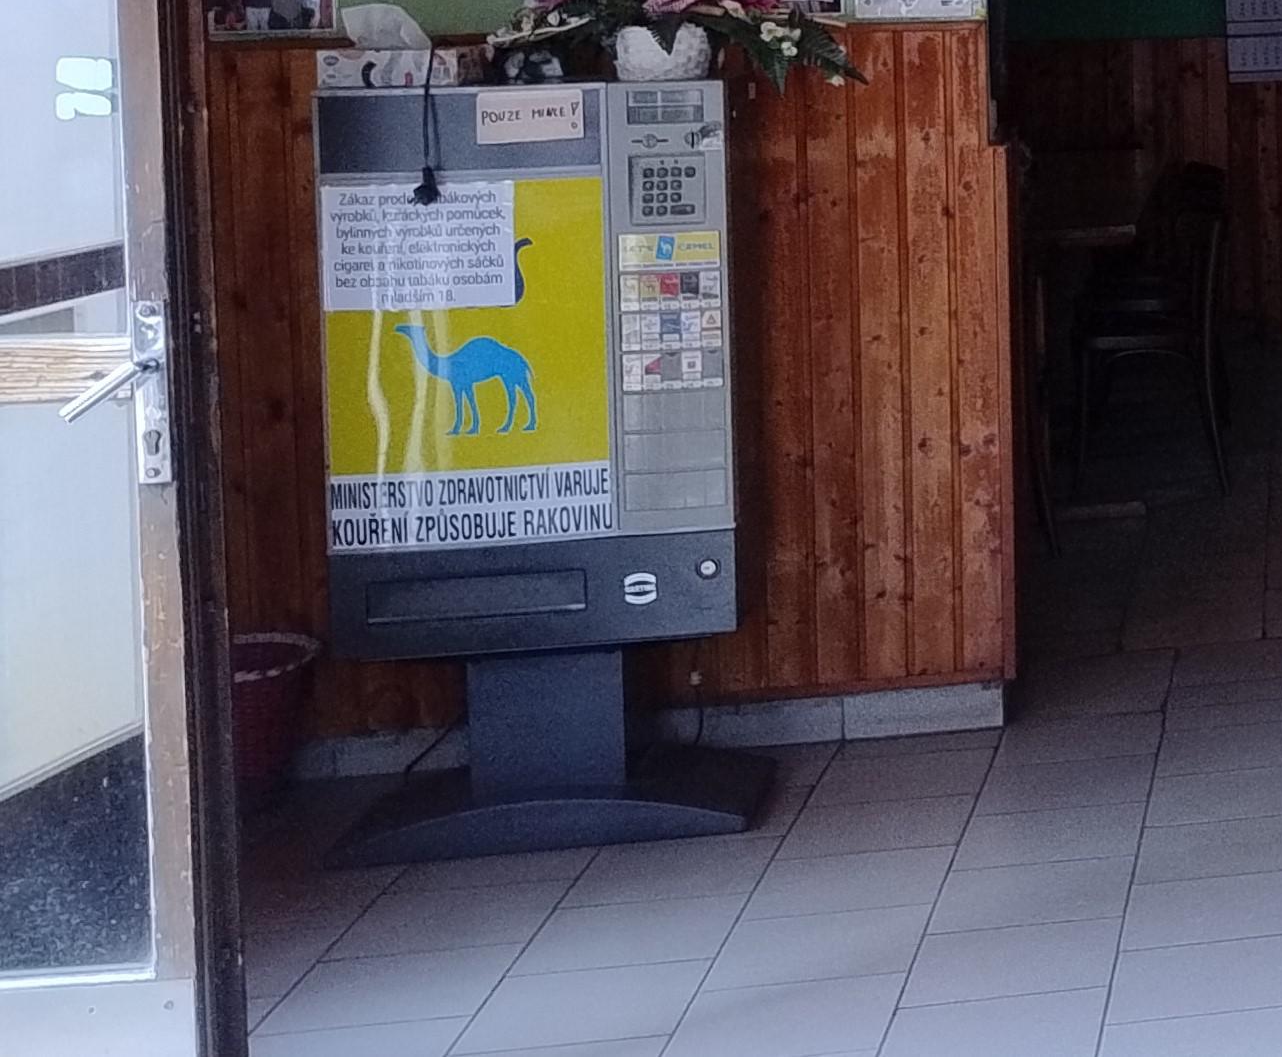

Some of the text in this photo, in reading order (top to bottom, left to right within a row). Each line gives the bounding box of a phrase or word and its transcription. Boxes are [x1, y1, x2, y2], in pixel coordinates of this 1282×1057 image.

[481, 110, 521, 126] POUZE
[339, 193, 375, 206] Zákaz
[341, 243, 356, 255] ke
[378, 261, 385, 271] a
[467, 255, 504, 269] sáčků
[336, 275, 356, 287] bez
[452, 273, 503, 286] osobám
[331, 467, 609, 510] MINISTERSTVO ZDRAVOTNICTVÍ VARUJE
[332, 504, 613, 547] KOUŘENÍ ZPŮSOBUJE RAKOVINU
